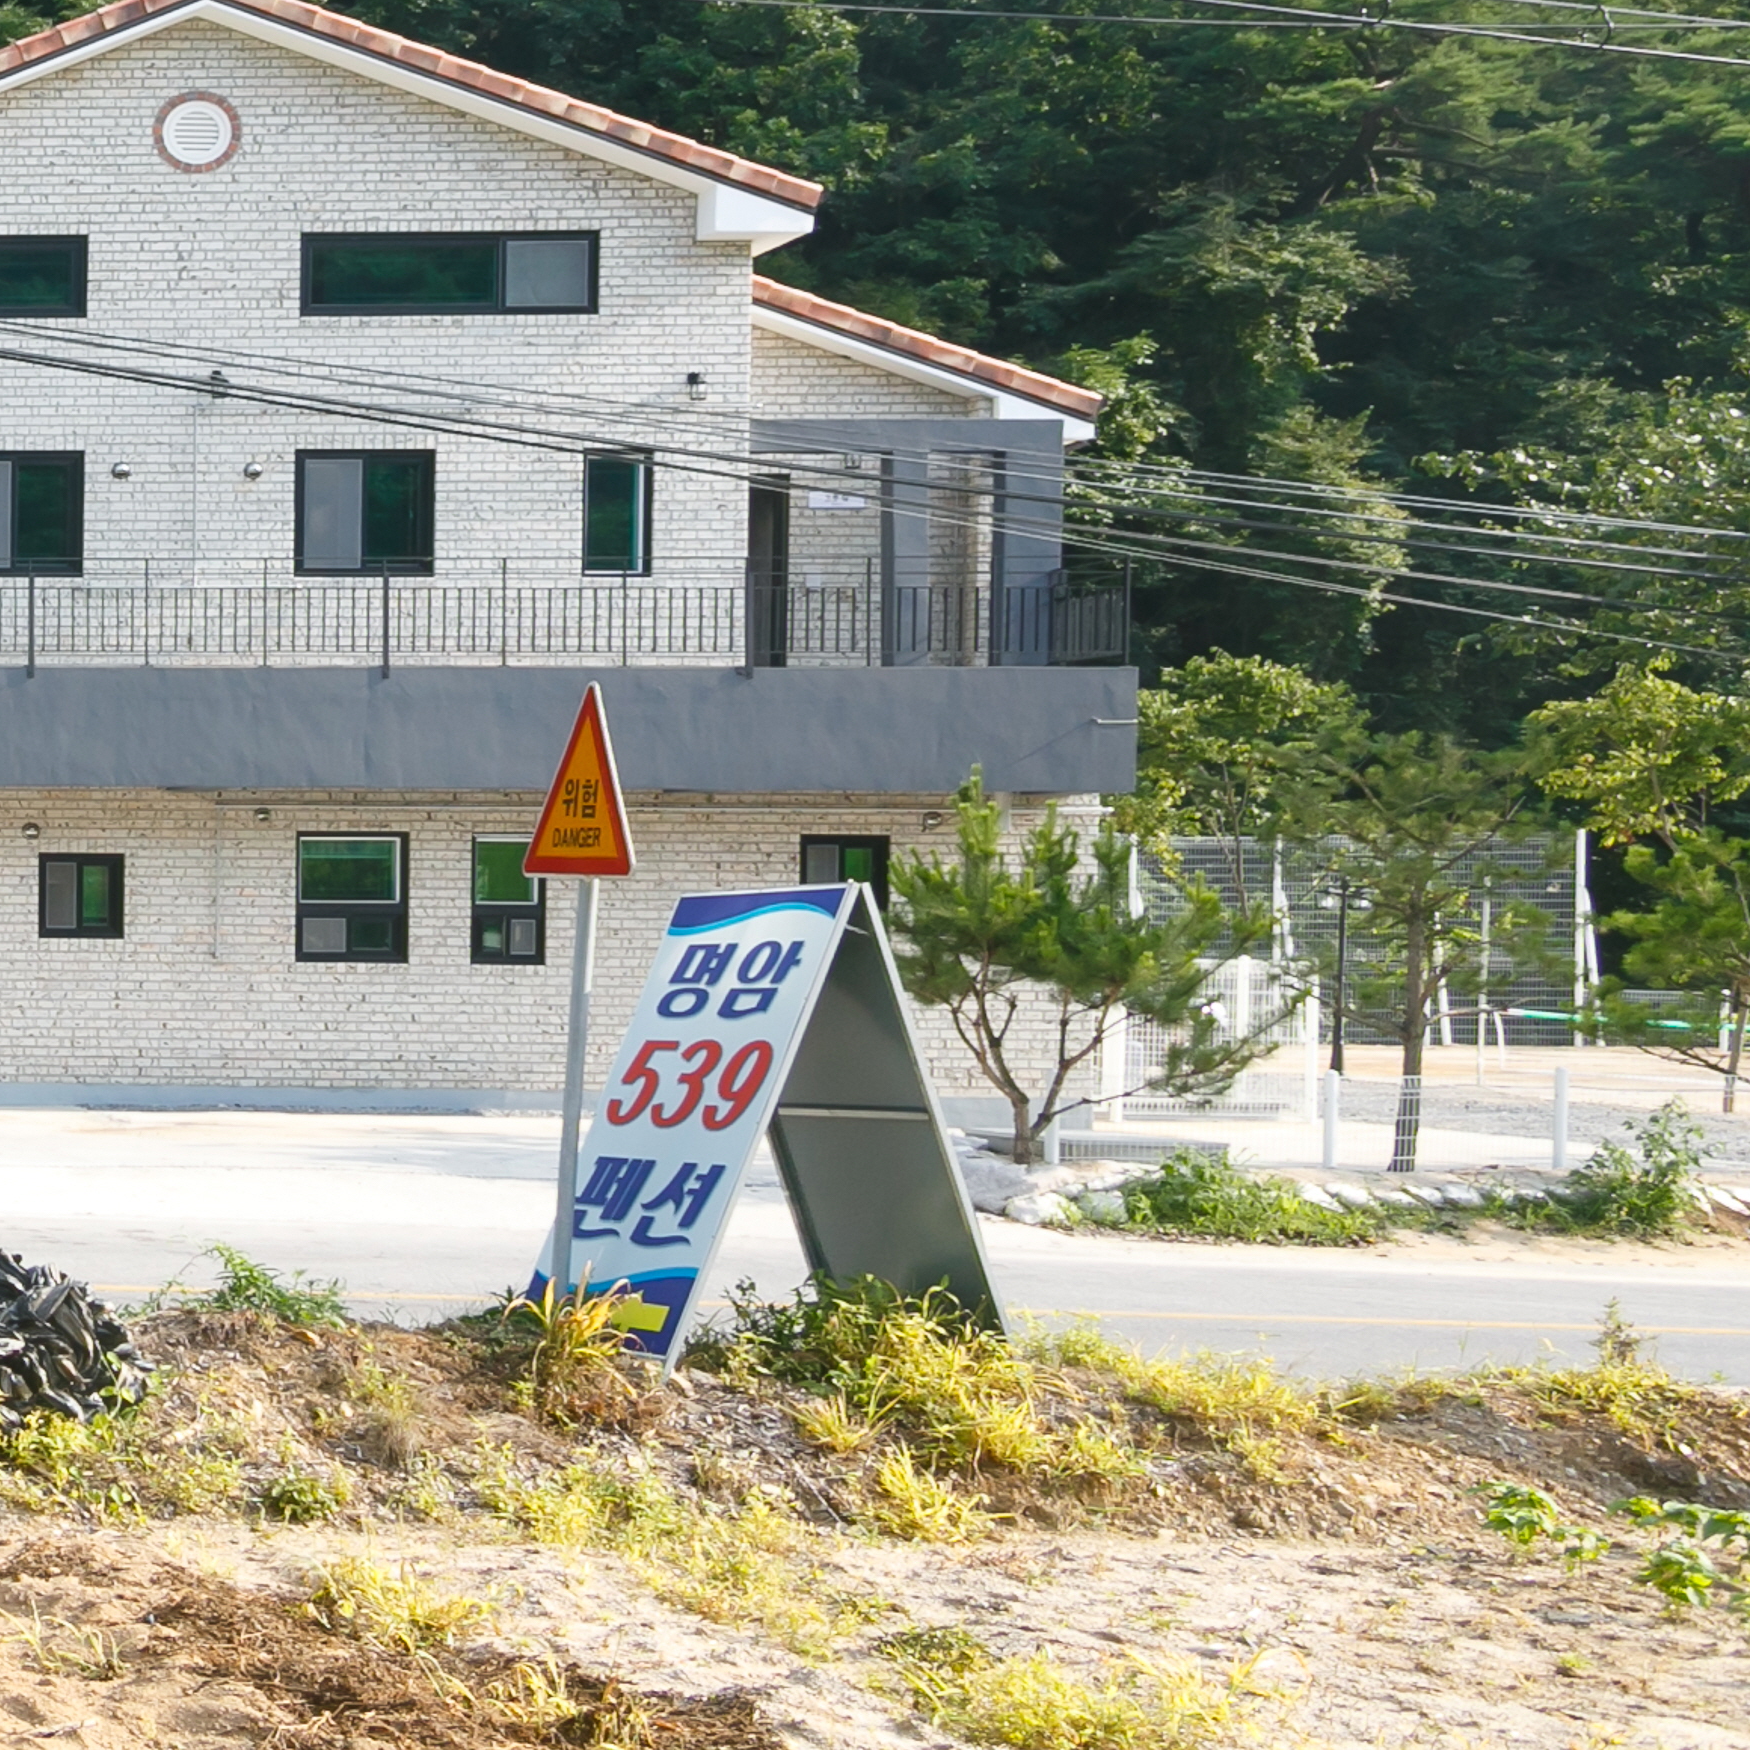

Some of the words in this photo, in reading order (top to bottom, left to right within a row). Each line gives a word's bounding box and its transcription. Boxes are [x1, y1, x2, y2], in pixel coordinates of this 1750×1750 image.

[552, 828, 601, 848] DANGER
[562, 779, 599, 818] 위험
[656, 940, 805, 1019] 명암
[607, 1039, 774, 1131] 539
[573, 1156, 727, 1246] 펜션
